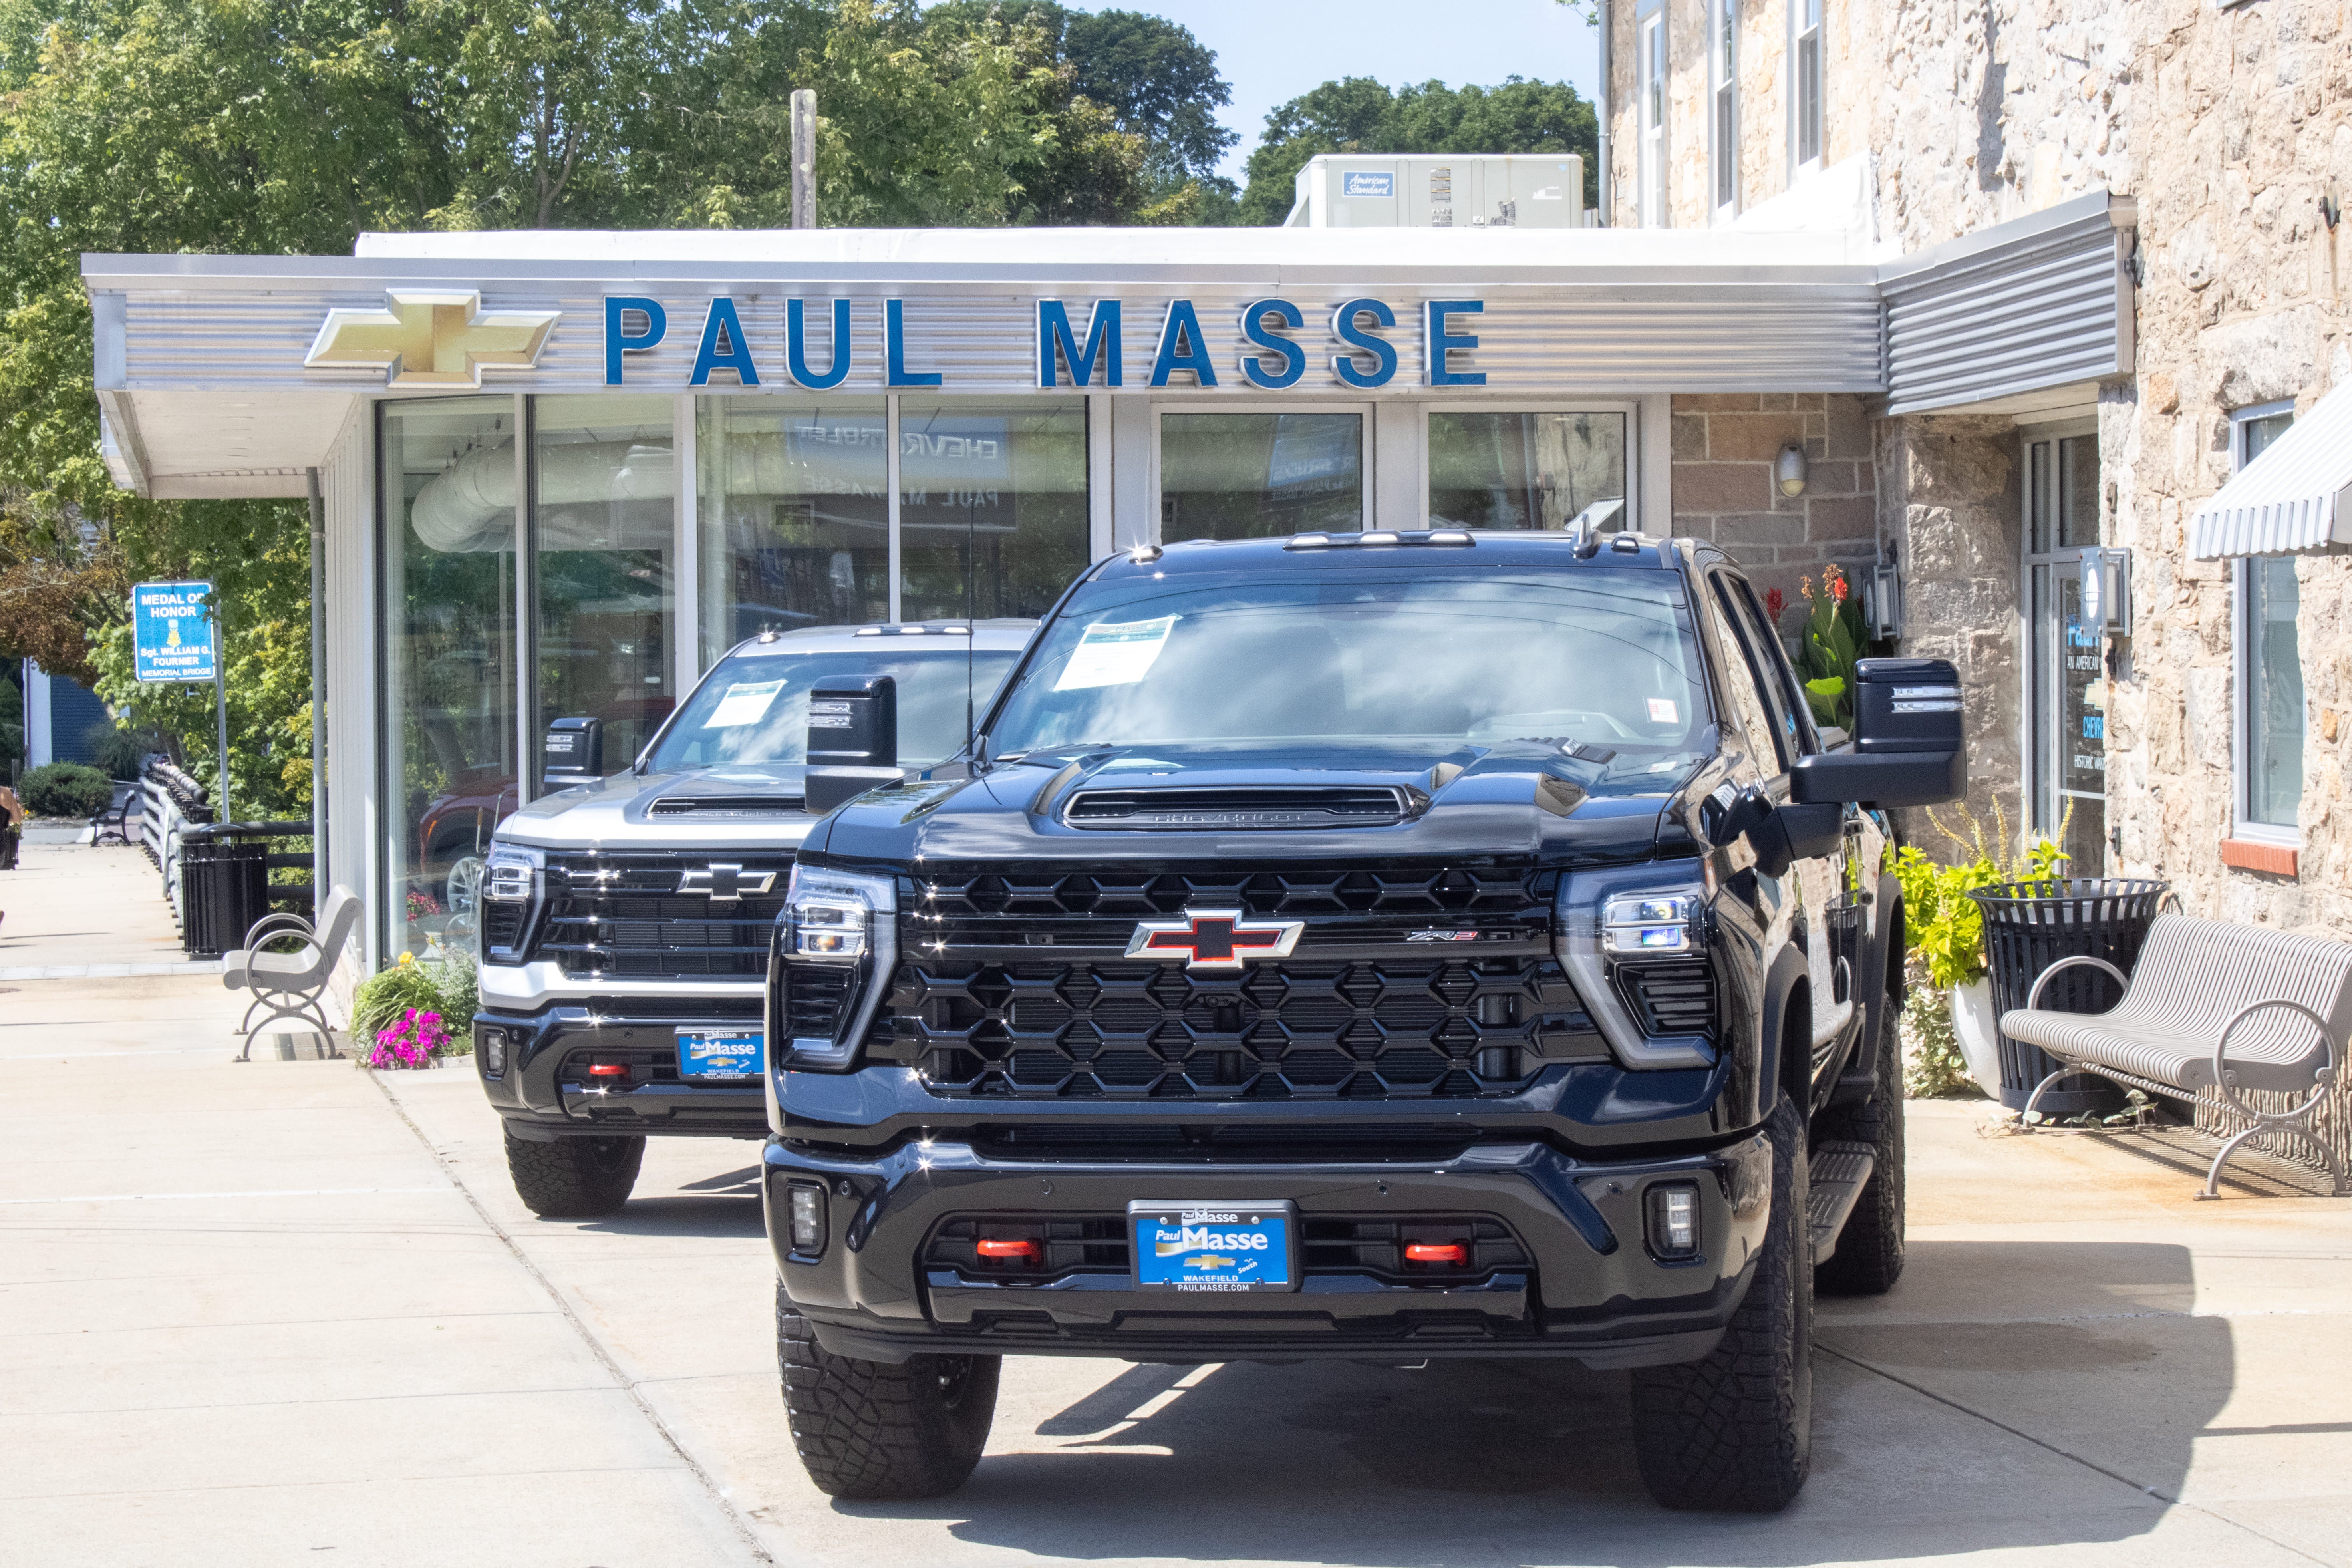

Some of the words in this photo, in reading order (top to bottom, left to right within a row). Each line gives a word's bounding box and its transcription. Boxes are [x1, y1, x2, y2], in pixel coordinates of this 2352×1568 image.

[1349, 174, 1389, 185] American
[1347, 184, 1388, 195] Standard
[604, 295, 942, 390] PAUL
[1036, 298, 1486, 390] MASSE
[142, 594, 184, 604] MEDAL
[151, 606, 196, 617] HONOR
[141, 648, 158, 658] Sgt.
[161, 646, 199, 655] WILLIAM
[201, 646, 210, 654] G.
[153, 657, 199, 666] FOURNIER
[2067, 656, 2074, 669] AN
[2076, 656, 2098, 670] AMERICAN
[2074, 755, 2093, 769] HISTORIC
[1406, 931, 1478, 940] ZR2
[706, 1041, 755, 1054] Masse
[1194, 1209, 1238, 1222] Masse
[1156, 1230, 1180, 1240] Paul
[1182, 1227, 1267, 1250] Masse
[1238, 1260, 1257, 1273] South
